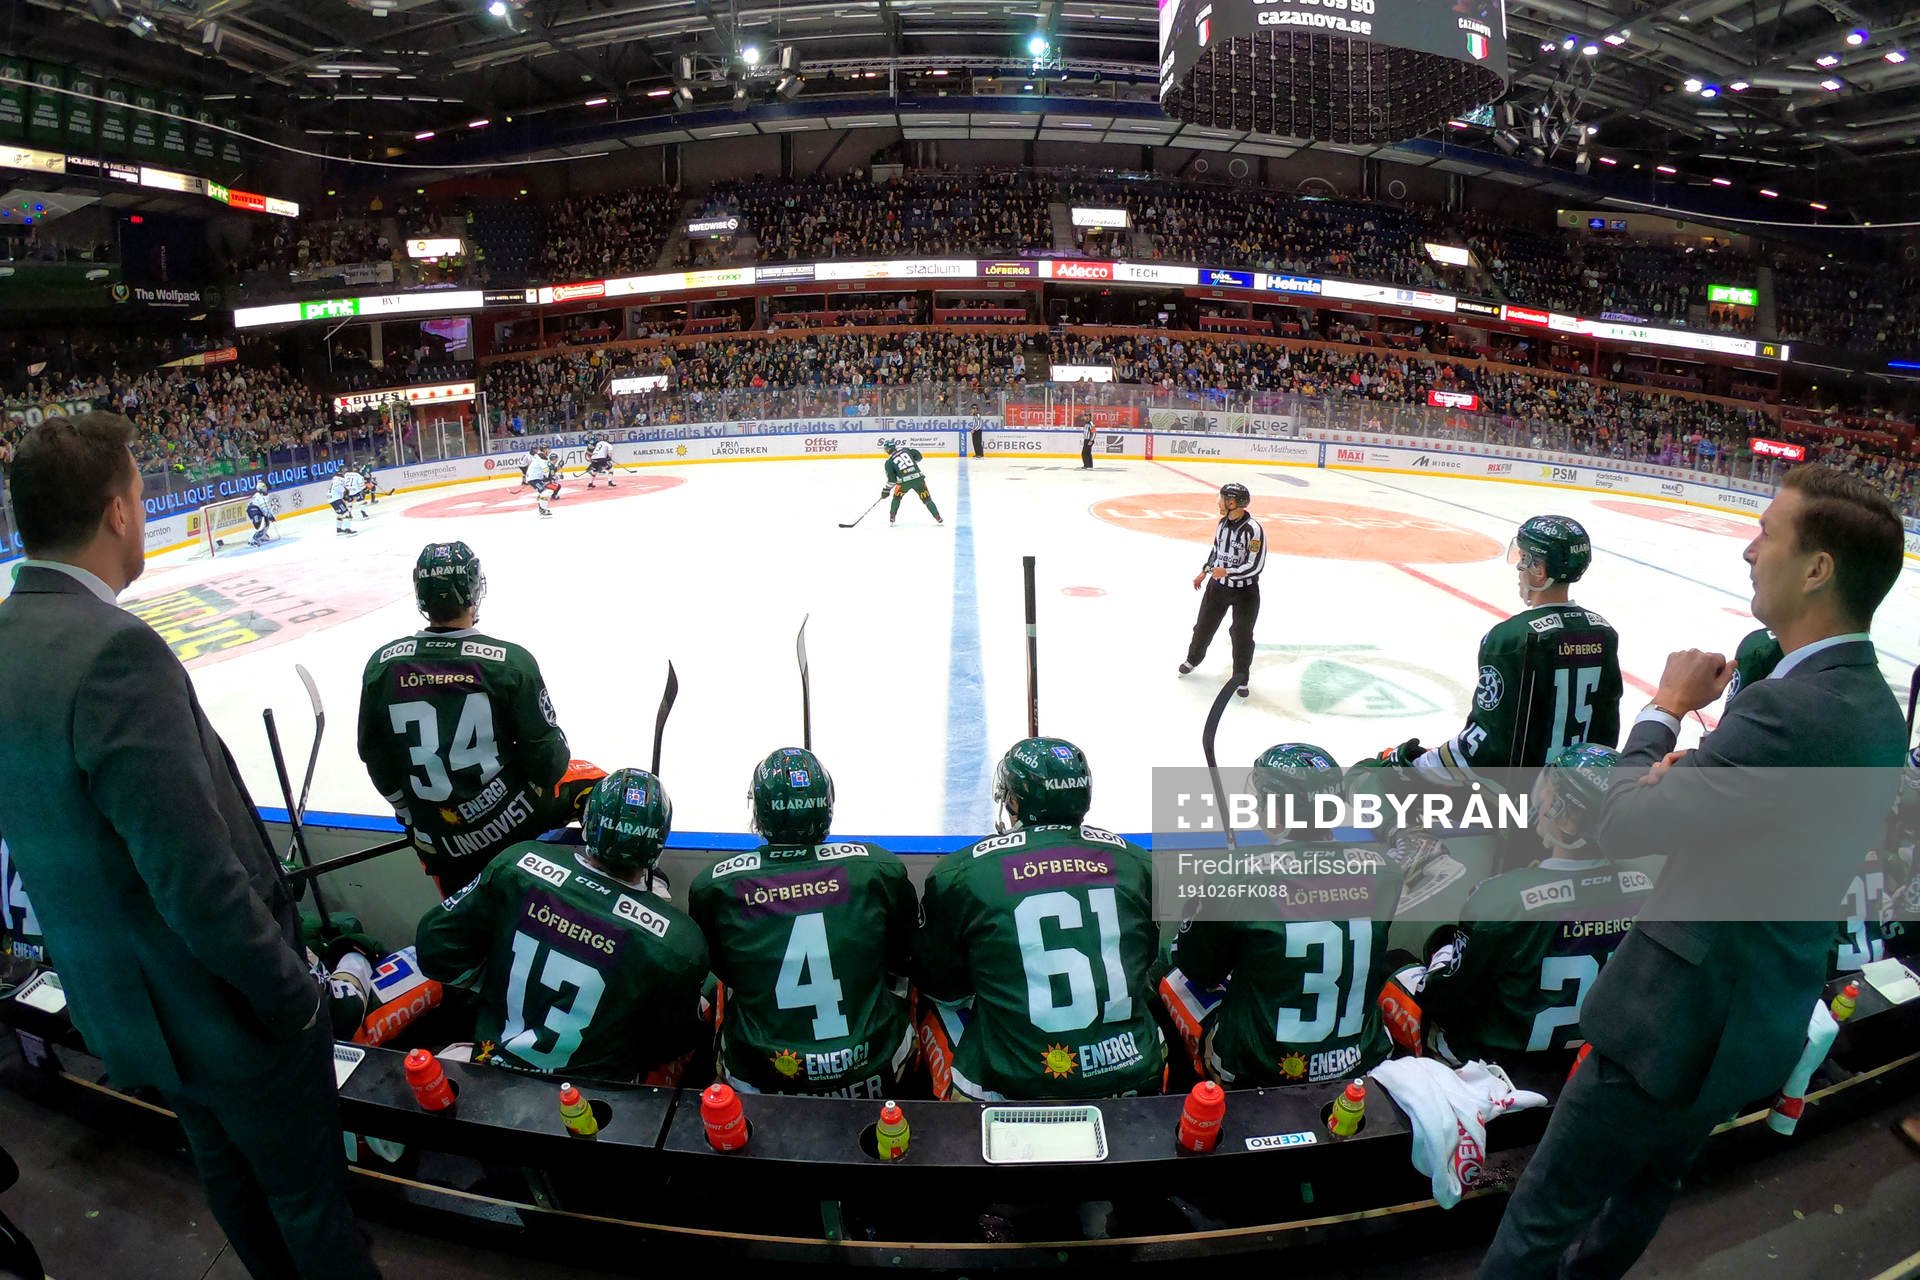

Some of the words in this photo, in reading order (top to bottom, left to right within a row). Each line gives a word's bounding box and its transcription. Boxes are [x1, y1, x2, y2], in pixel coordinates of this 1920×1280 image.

[1258, 11, 1372, 35] cazanova.se
[67, 156, 100, 168] HOLBERG
[110, 163, 139, 174] NIELSEN
[689, 221, 728, 232] SWEDWISE
[905, 263, 961, 275] stadium
[985, 265, 1031, 276] LÖFBERGS
[1056, 263, 1109, 278] Adecco
[1130, 268, 1159, 278] TECH
[135, 288, 154, 300] The
[156, 289, 201, 303] Wolfpack
[306, 299, 355, 320] print
[758, 421, 836, 434] Gårdfeldts
[1253, 420, 1289, 432] suez
[805, 437, 838, 446] Office
[805, 445, 838, 453] DEPOT
[982, 438, 1042, 451] LÖFBERGS
[893, 452, 914, 471] 28
[1198, 448, 1221, 456] frakt
[1337, 449, 1364, 461] MAXI
[1432, 461, 1461, 469] MIDROC
[1552, 467, 1577, 481] PSM
[220, 474, 263, 496] CLIQUE
[268, 466, 307, 485] CLIQUE
[1596, 473, 1623, 482] Karlstads
[1105, 508, 1472, 536] betson
[418, 565, 467, 579] KLARAVIK
[1533, 615, 1561, 631] elon
[383, 642, 413, 659] elon
[464, 643, 503, 659] elon
[1559, 642, 1602, 656] LÖFBERGS
[401, 672, 475, 688] LÖFBERGS
[388, 692, 504, 802] 34
[1014, 747, 1038, 769] Lecab
[1268, 754, 1296, 776] Lecab
[1576, 761, 1609, 792] Lecab
[458, 777, 508, 821] ENERGI
[772, 797, 828, 811] KLARAVIK
[600, 814, 659, 840] KLARAVIK
[976, 833, 1023, 853] elon
[1034, 824, 1072, 833] CCM
[1084, 829, 1124, 848] elon
[715, 855, 758, 874] elon
[769, 850, 807, 858] CCM
[819, 846, 865, 859] elon
[1303, 850, 1336, 858] CCM
[1013, 858, 1109, 881] LÖFBERGS
[524, 856, 565, 882] elon
[575, 875, 612, 895] CCM
[618, 900, 665, 934] elon
[745, 879, 840, 906] LÖFBERGS
[1286, 884, 1369, 906] LÖFBERGS
[1525, 882, 1572, 905] elon
[1581, 876, 1612, 887] CCM
[528, 902, 616, 955] LÖFBERGS
[1014, 887, 1132, 1033] 61
[775, 912, 850, 1040] 4
[1276, 917, 1373, 1043] 31
[501, 930, 606, 1071] 13
[1526, 954, 1600, 1052] 2
[806, 1041, 869, 1076] ENERGI
[1079, 1031, 1140, 1072] ENERGI
[1309, 1044, 1362, 1076] ENERGI
[1250, 1133, 1306, 1147] ICEPRO
